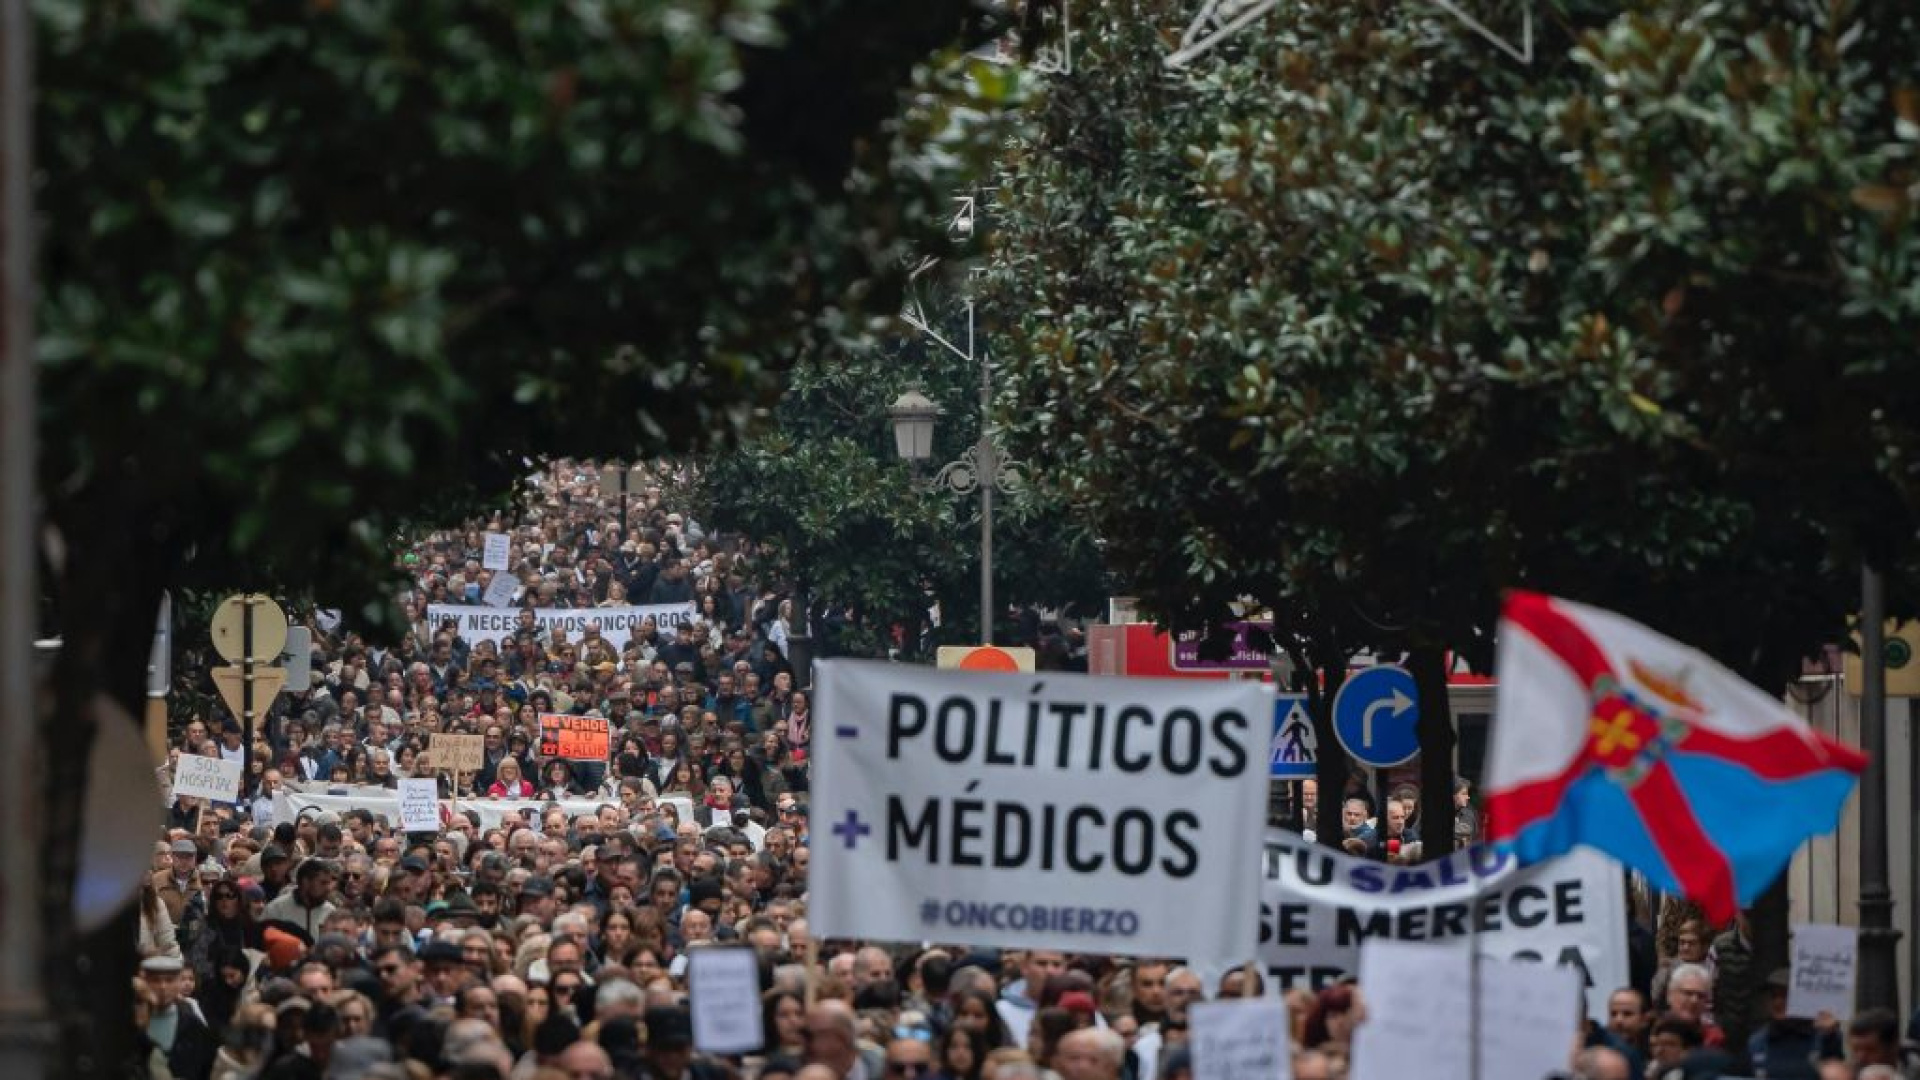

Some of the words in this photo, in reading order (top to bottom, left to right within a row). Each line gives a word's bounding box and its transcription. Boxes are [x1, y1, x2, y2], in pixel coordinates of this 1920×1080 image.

[469, 614, 586, 633] NECESAMOS
[560, 717, 608, 733] VENDE
[886, 682, 1249, 779] POLÍTICOS
[195, 757, 220, 774] SOS
[885, 781, 1201, 878] MÉDICOS
[1264, 843, 1335, 886] TU
[919, 900, 1140, 937] #ONCOBIERZO
[1335, 879, 1584, 946] MERECE
